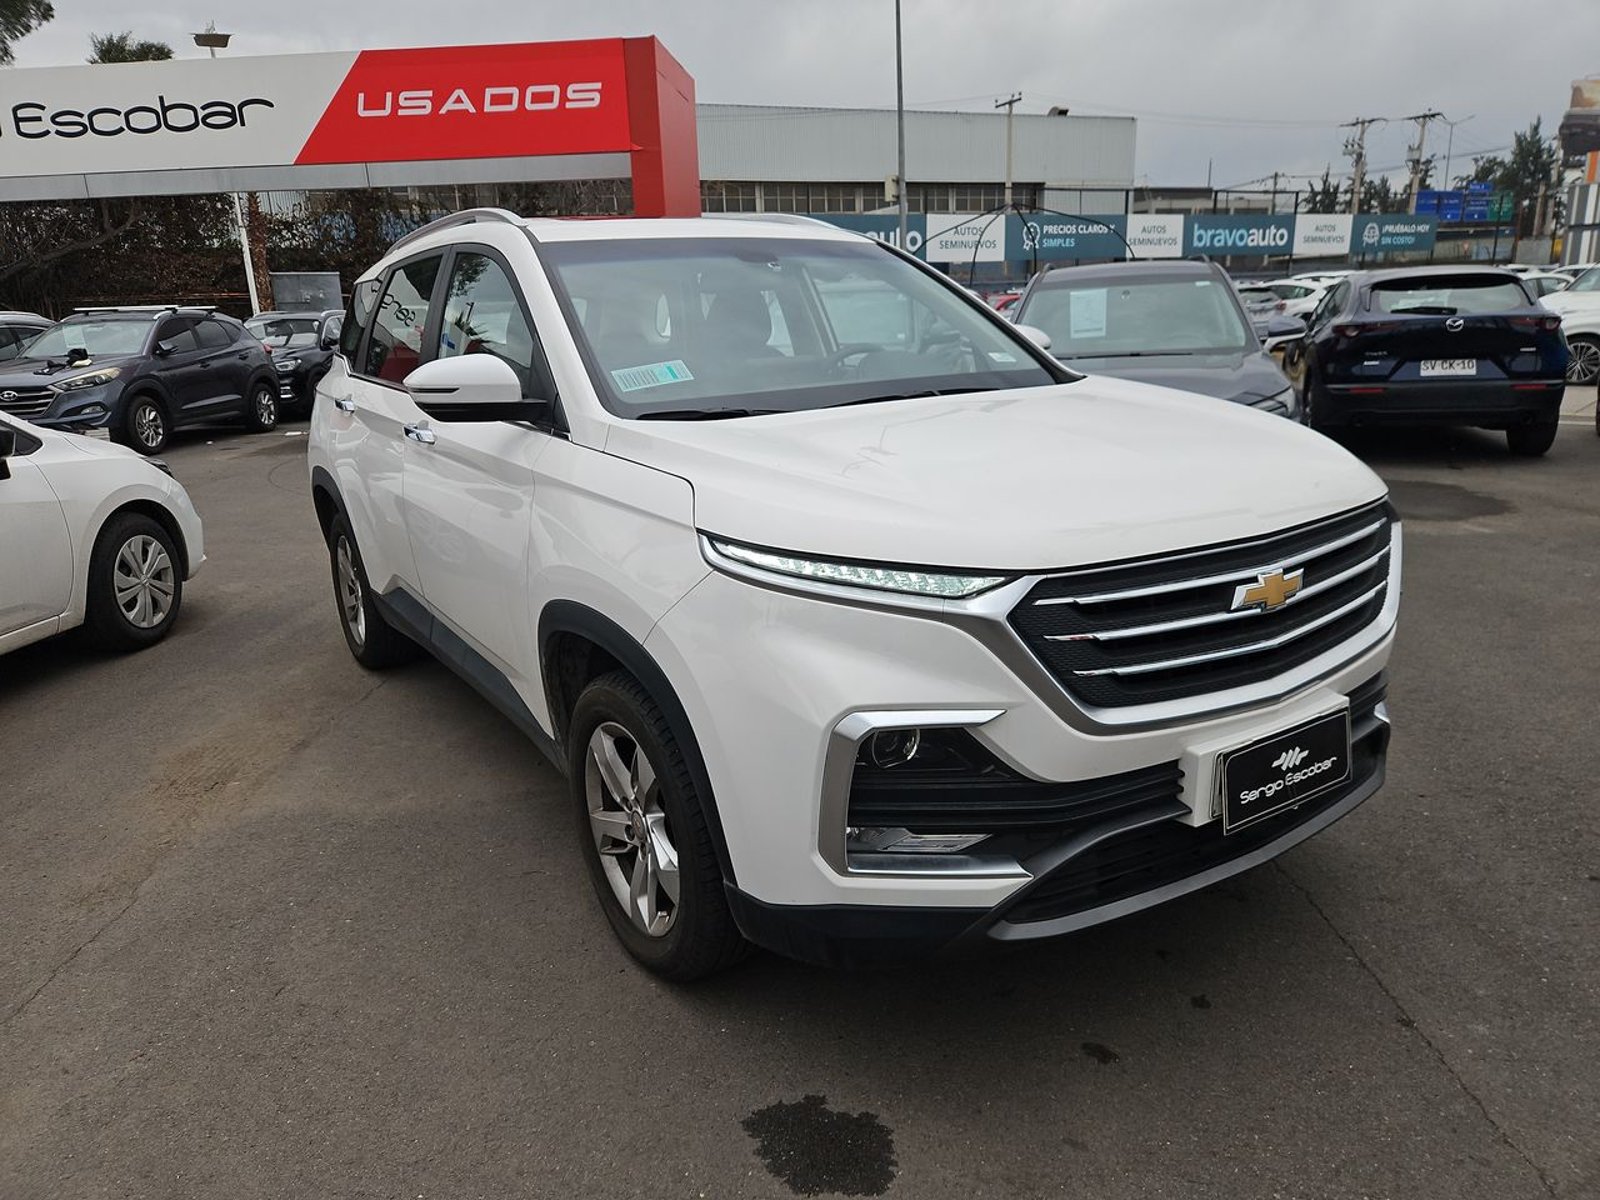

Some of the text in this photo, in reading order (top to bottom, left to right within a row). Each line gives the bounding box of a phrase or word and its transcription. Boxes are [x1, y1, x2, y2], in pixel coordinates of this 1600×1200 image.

[358, 83, 601, 116] USADOS
[12, 96, 274, 138] Escobar
[953, 226, 983, 236] AUTOS
[1043, 224, 1077, 234] PRECIOS
[1078, 224, 1108, 234] CLAROS
[1141, 225, 1167, 234] AUTOS
[1314, 224, 1336, 233] AUTOS
[1193, 223, 1289, 247] bravoauto
[1302, 236, 1345, 244] SEMINUEVOS
[939, 239, 997, 250] SEMINUEVOS
[1042, 238, 1076, 247] SIMPLES
[1129, 237, 1178, 247] SEMINUEVOS
[1240, 757, 1337, 804] Sergo Escobar
